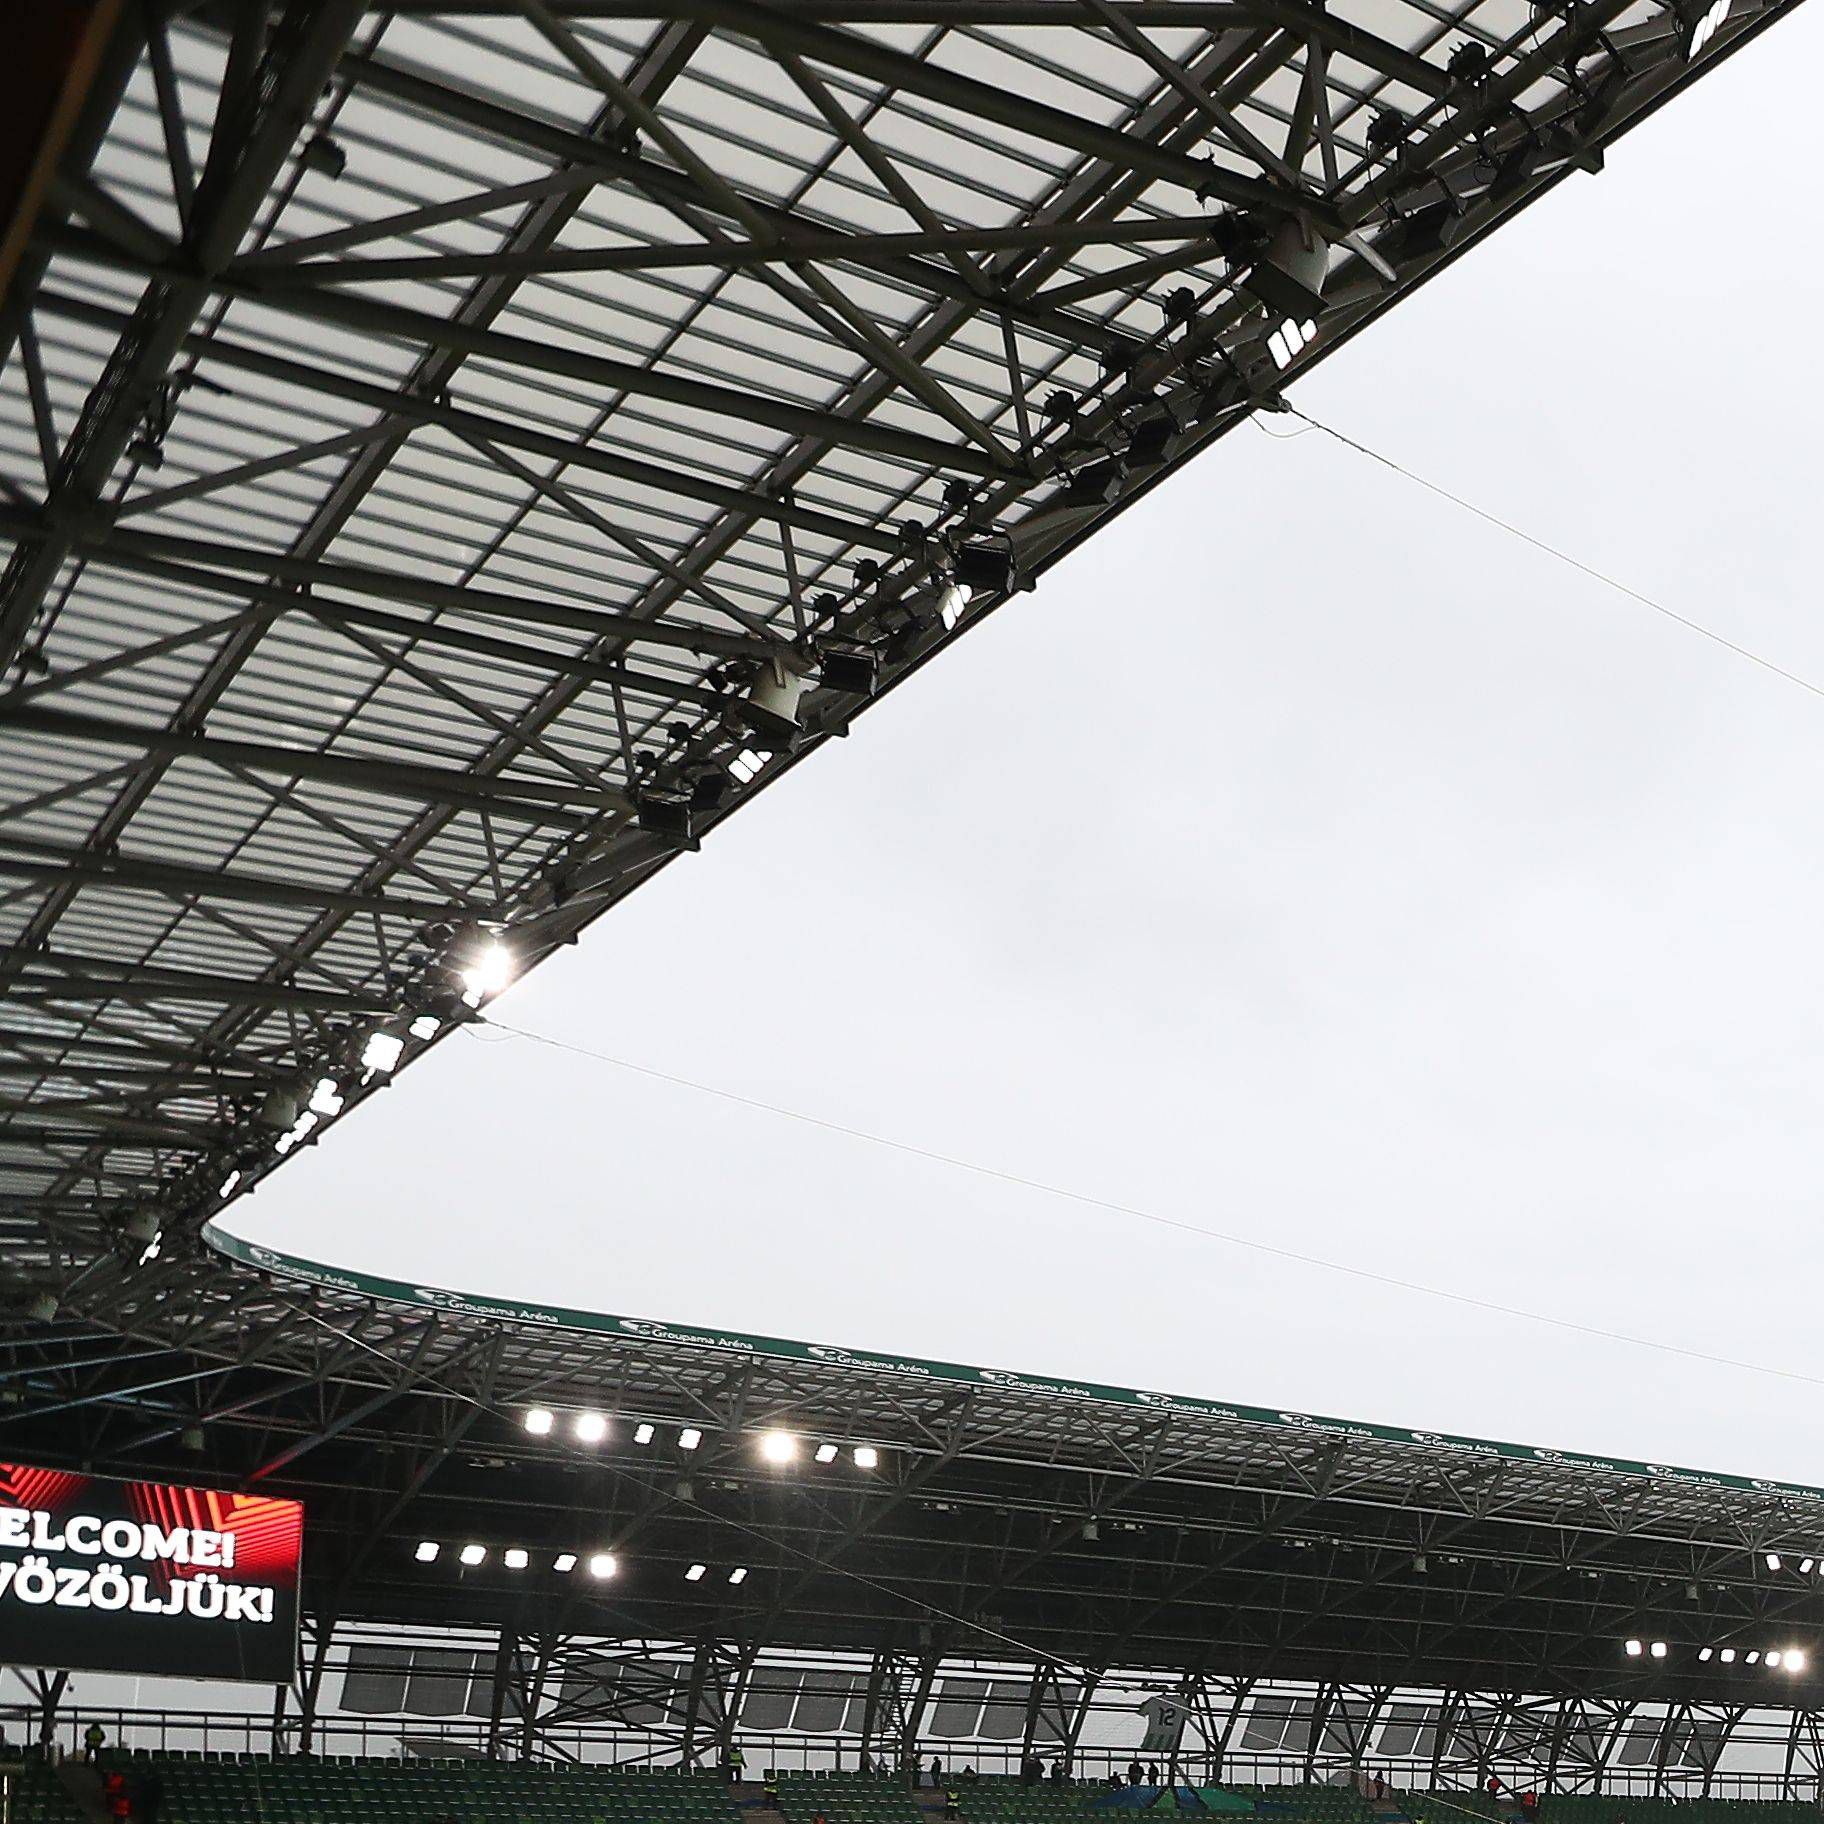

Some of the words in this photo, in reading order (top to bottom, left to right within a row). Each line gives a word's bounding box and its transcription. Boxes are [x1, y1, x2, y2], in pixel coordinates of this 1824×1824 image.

[449, 1297, 515, 1318] Groupama
[520, 1309, 558, 1322] Aréna
[652, 1328, 714, 1345] Groupama
[720, 1338, 753, 1350] Aréna
[840, 1354, 896, 1371] Groupama
[901, 1362, 929, 1374] Aréna
[1006, 1379, 1058, 1395] Groupama
[1062, 1387, 1090, 1397] Aréna
[1161, 1399, 1208, 1414] Groupama
[1301, 1420, 1344, 1434] Groupama
[1432, 1438, 1471, 1453] Groupama
[1554, 1455, 1589, 1469] Groupama
[0, 1506, 236, 1568] ELCOME!
[1159, 1706, 1174, 1726] 12
